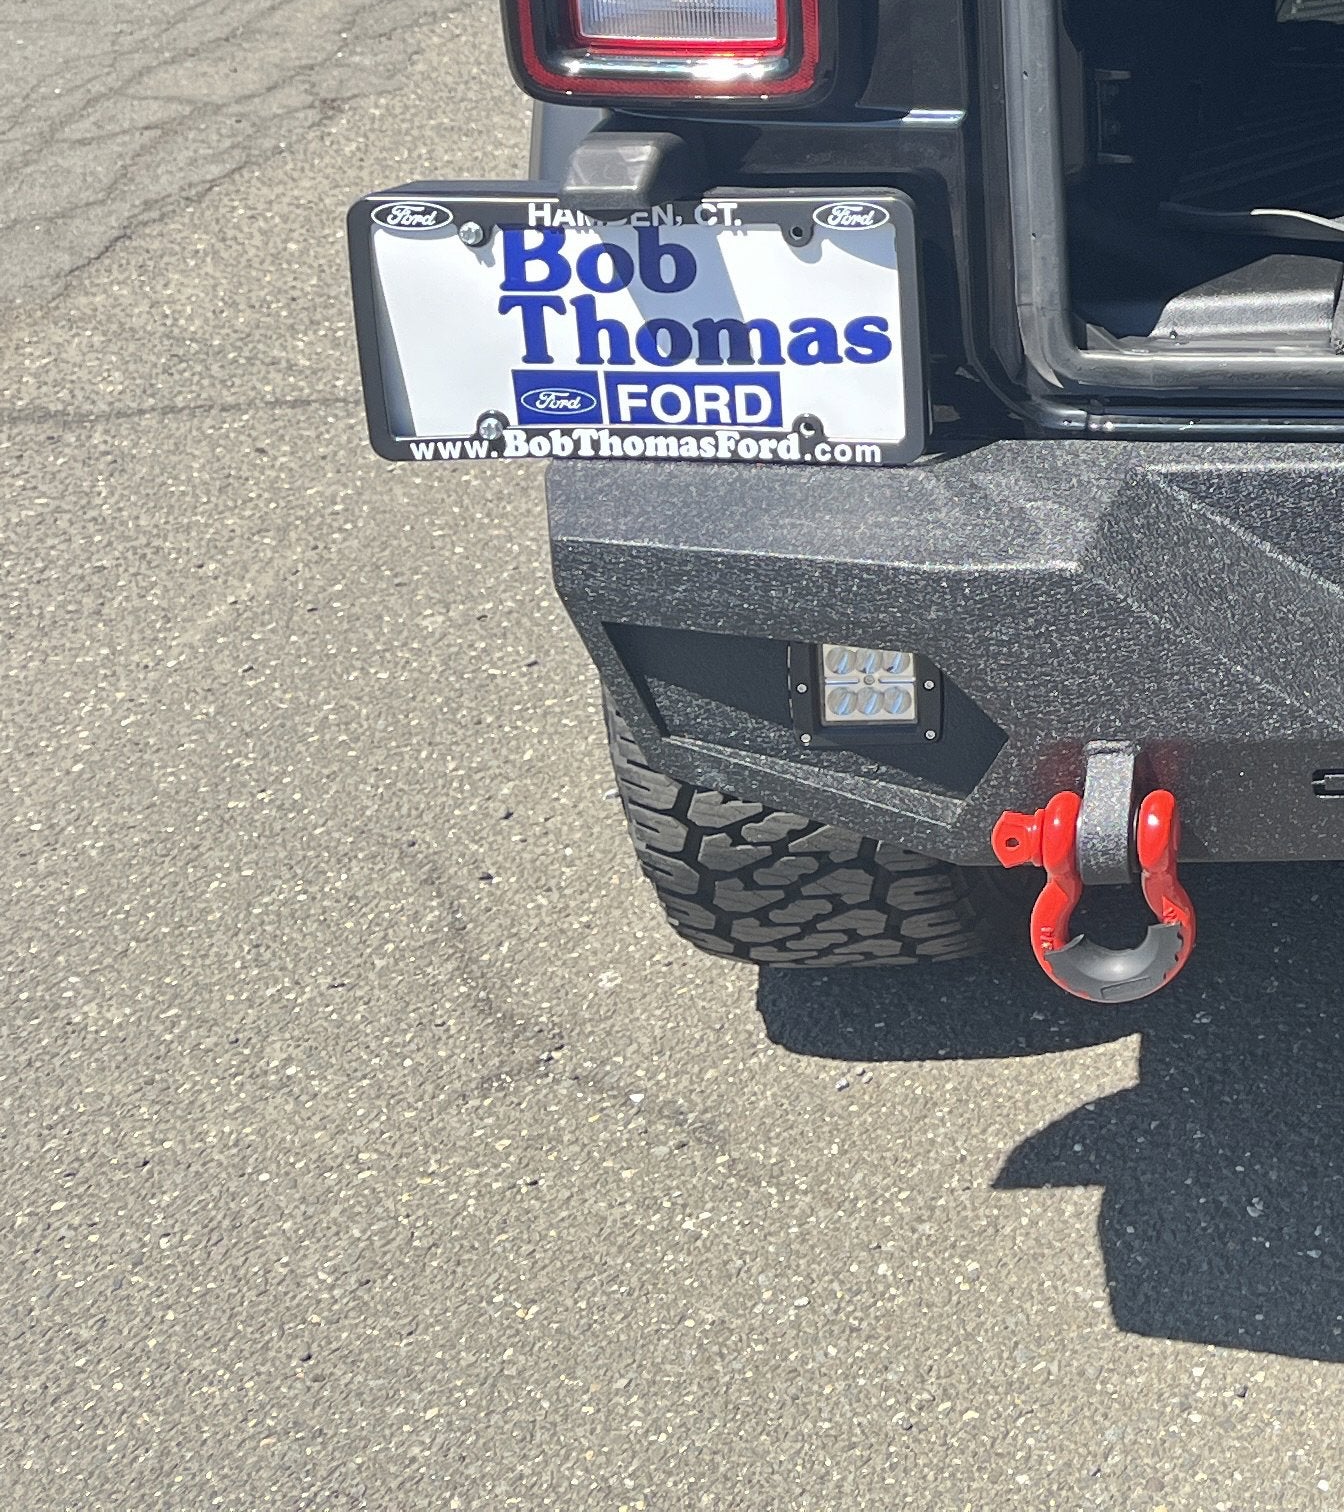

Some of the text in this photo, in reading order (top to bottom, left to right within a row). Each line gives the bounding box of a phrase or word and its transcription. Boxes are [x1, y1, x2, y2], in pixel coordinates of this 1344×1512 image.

[694, 202, 743, 227] CT.
[499, 223, 697, 294] Bob
[498, 294, 893, 367] Thomas
[616, 383, 772, 425] FORD
[409, 428, 882, 464] www.BobThomasFord.com
